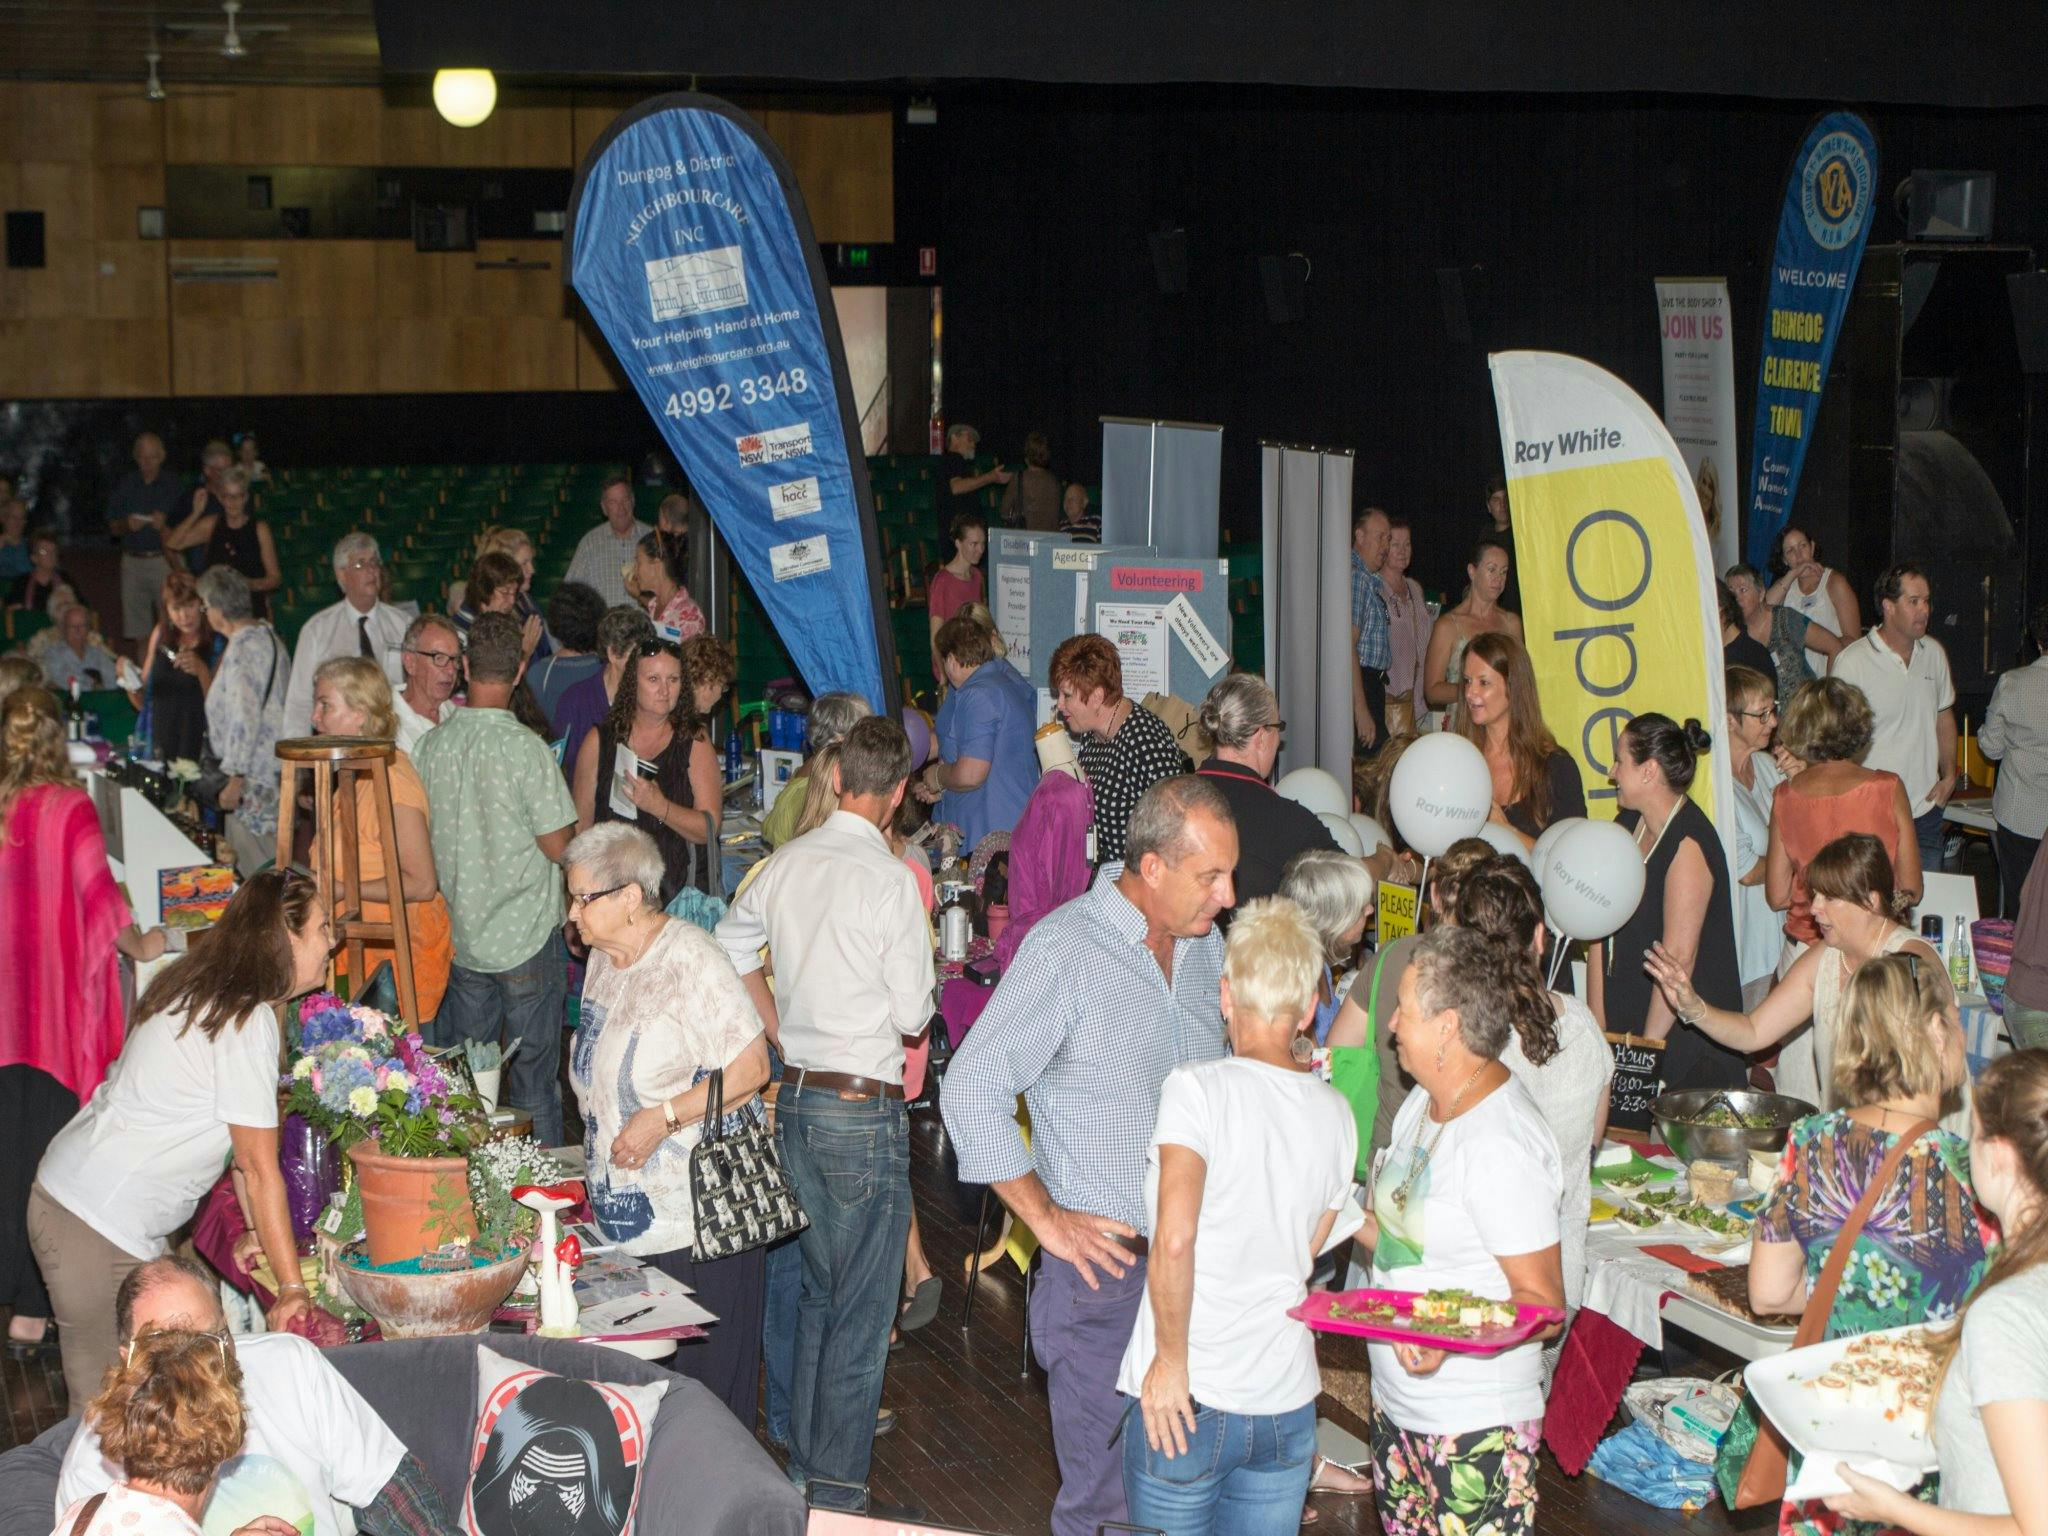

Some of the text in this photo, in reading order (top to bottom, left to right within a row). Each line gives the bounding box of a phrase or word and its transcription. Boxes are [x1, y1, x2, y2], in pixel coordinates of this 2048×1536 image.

[617, 165, 673, 187] Dungog
[675, 160, 687, 175] &
[626, 188, 750, 248] NEIGHBOURCARE
[675, 225, 706, 246] INC
[1778, 267, 1848, 290] WELCOME
[1675, 298, 1686, 308] THE
[1687, 297, 1701, 308] BODY
[1702, 298, 1716, 308] SHOP
[631, 309, 800, 351] Your Helping Hand at Home
[1662, 315, 1723, 340] JOIN US
[1772, 309, 1824, 344] DUNGOG
[646, 339, 791, 375] www.neighbourcare.org.au
[1763, 356, 1821, 393] CLARENCE
[664, 368, 808, 420] 4992 3348
[1770, 405, 1803, 440] TOWN
[769, 435, 812, 451] Transport
[771, 446, 807, 461] for NSW
[1514, 427, 1622, 464] Ray White
[740, 451, 764, 465] NSW
[781, 487, 808, 503] hacc
[1003, 539, 1030, 552] Disability
[1054, 551, 1091, 563] Aged Ca
[1117, 572, 1196, 591] Volunteering
[1174, 617, 1207, 662] always welcome
[1177, 603, 1219, 661] New Volunteers are
[1416, 797, 1480, 820] Ray White
[1552, 860, 1612, 909] Ray White
[1380, 892, 1414, 919] PLEASE
[1615, 1043, 1656, 1068] Hours
